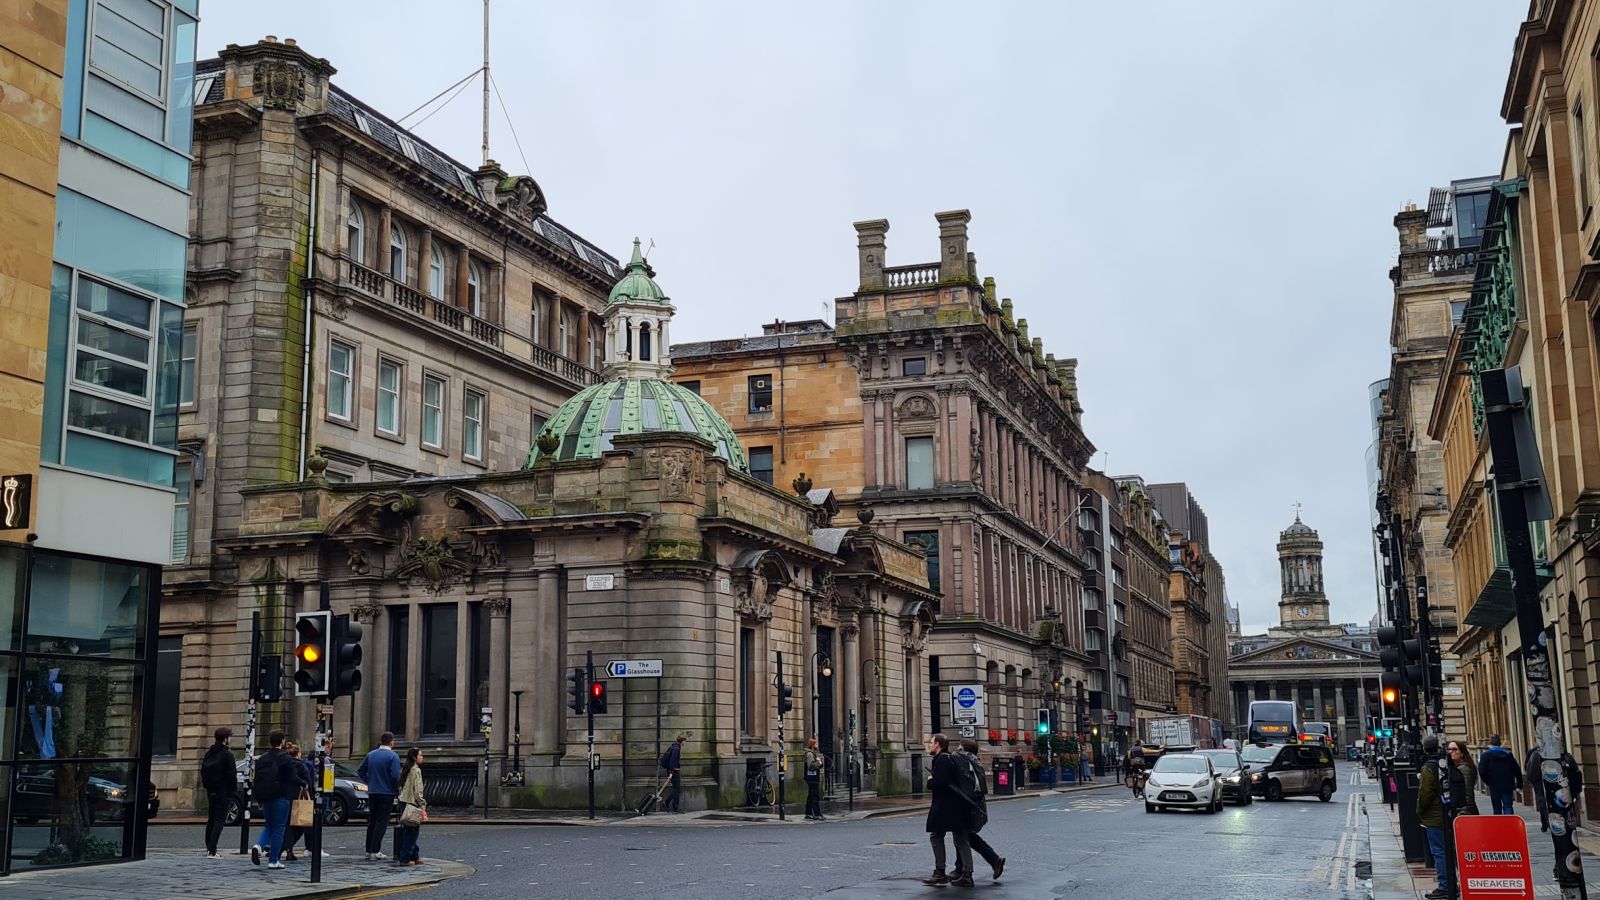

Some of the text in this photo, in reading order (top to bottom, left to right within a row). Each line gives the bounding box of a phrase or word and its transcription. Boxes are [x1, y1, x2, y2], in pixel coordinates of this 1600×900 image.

[617, 664, 625, 674] P
[1481, 852, 1522, 861] KERSHKICKS
[1469, 880, 1523, 888] SNEAKERS
